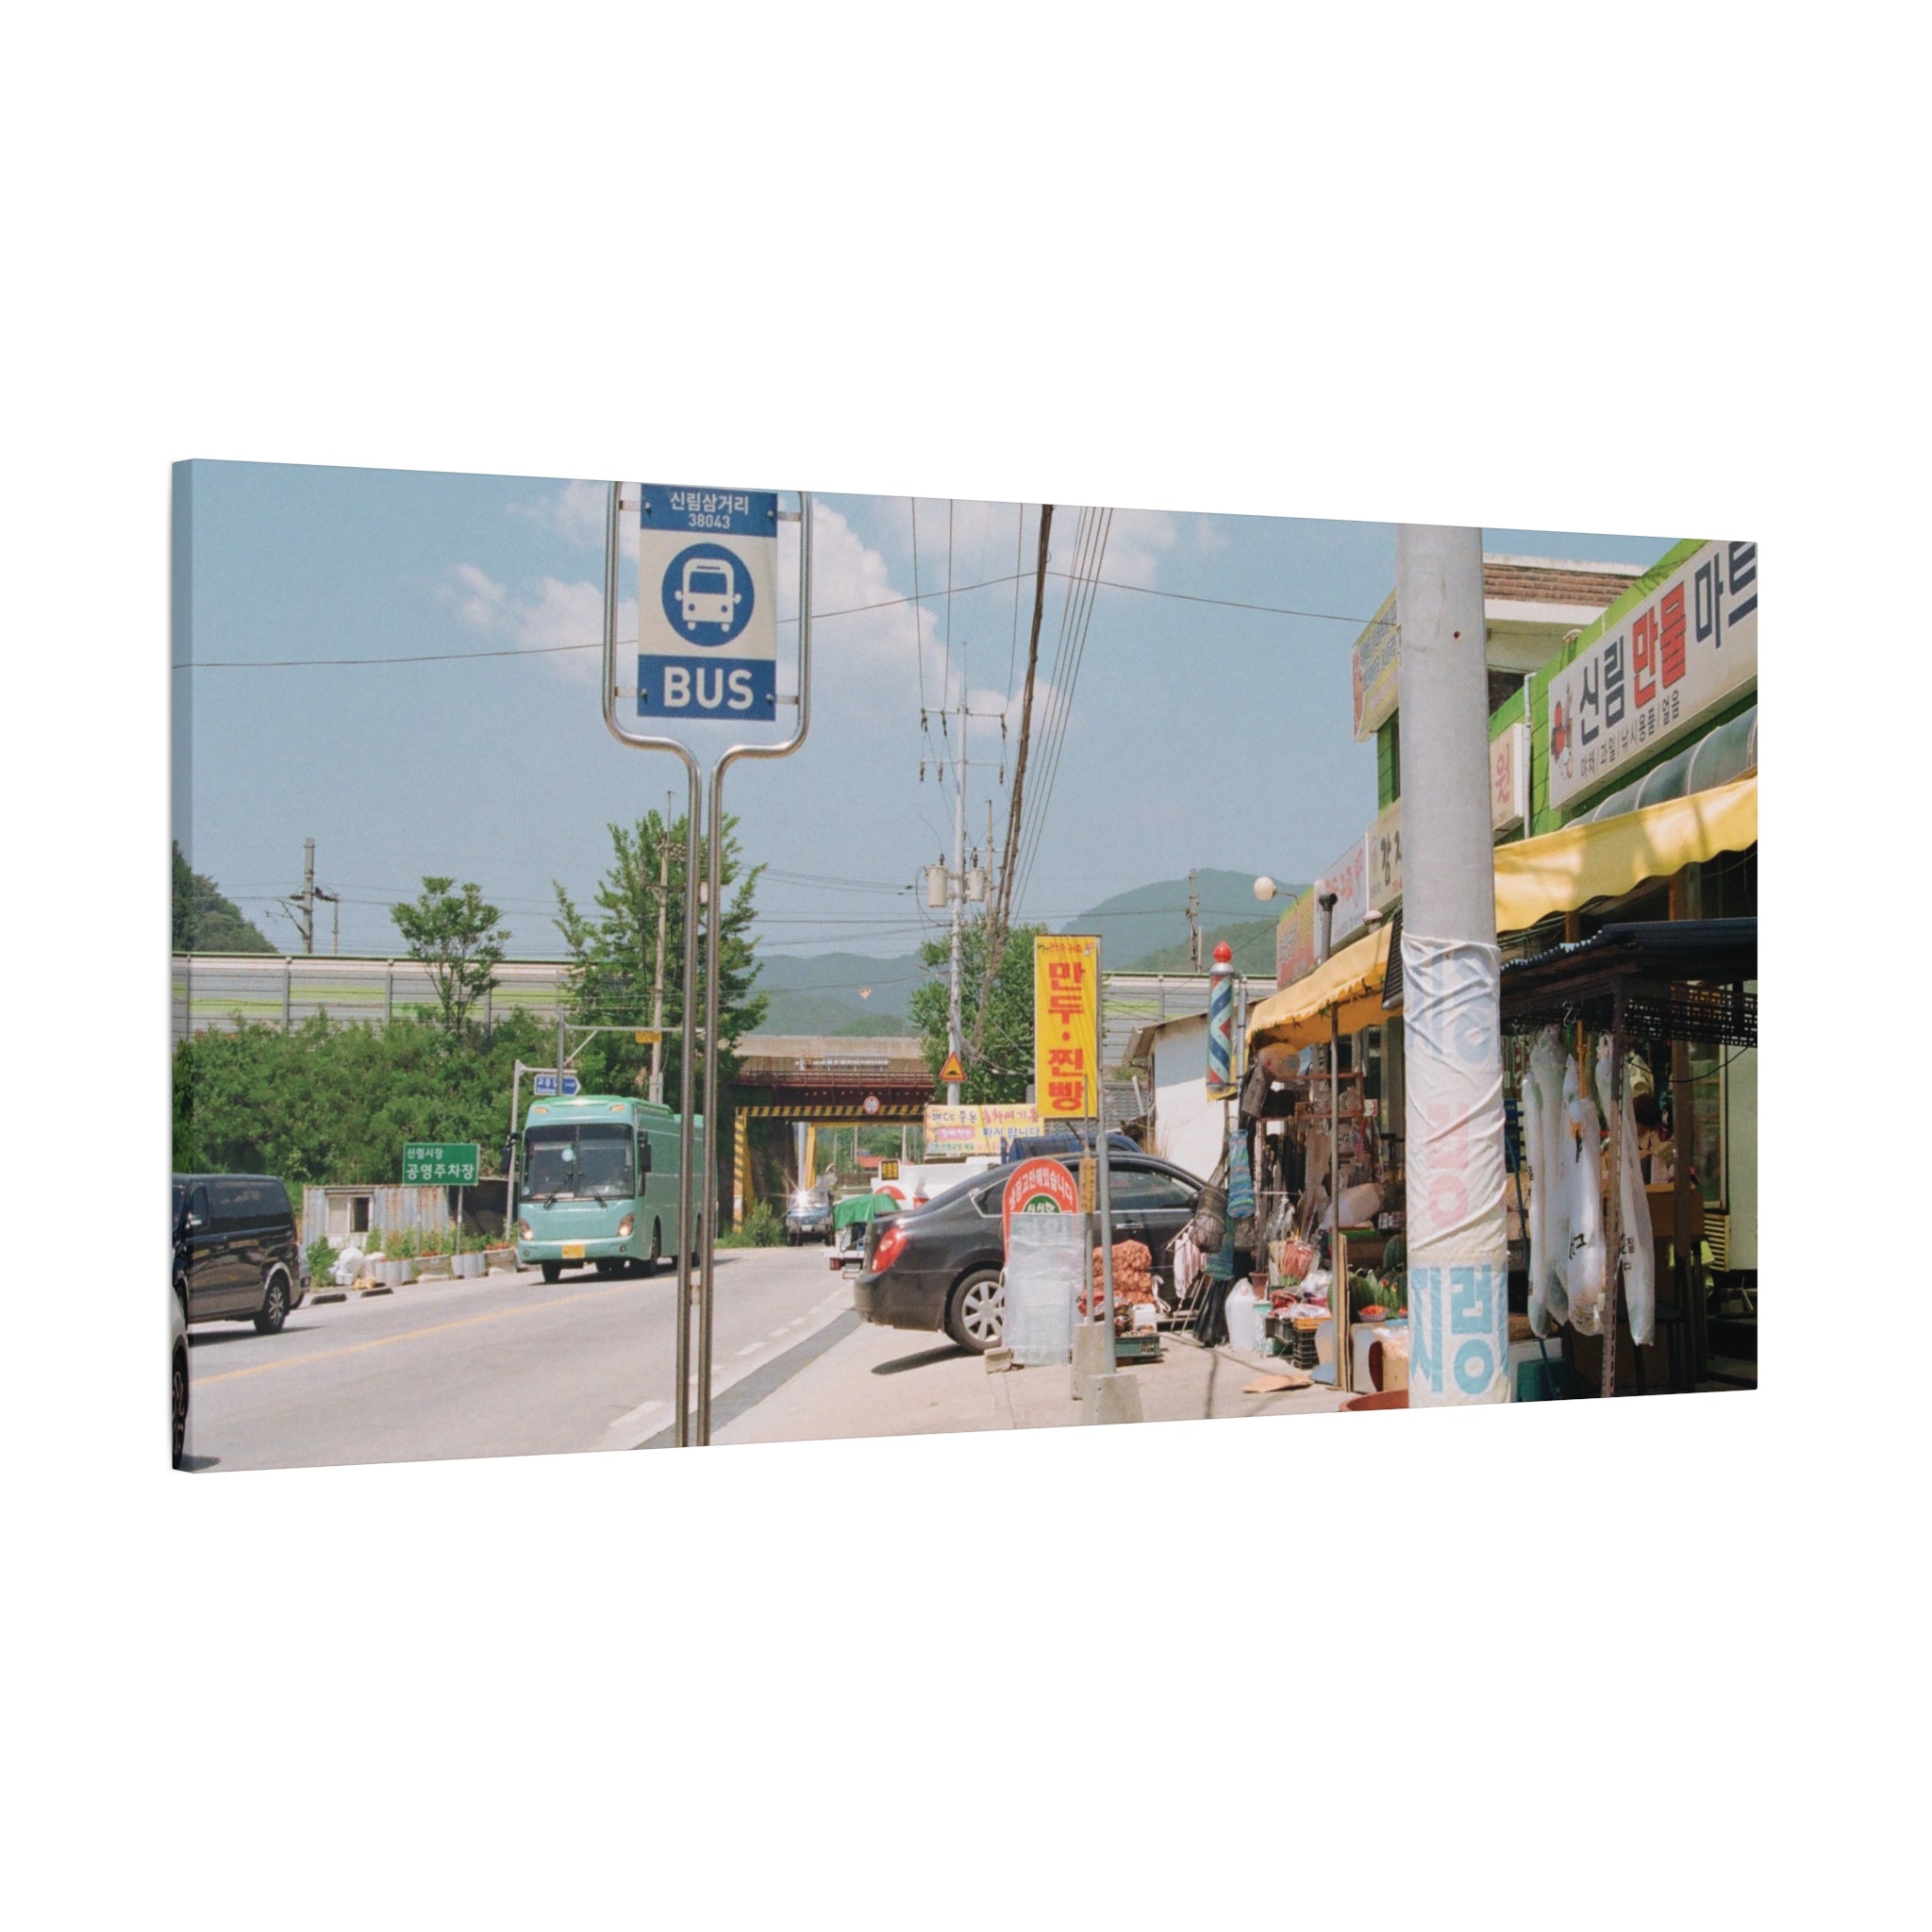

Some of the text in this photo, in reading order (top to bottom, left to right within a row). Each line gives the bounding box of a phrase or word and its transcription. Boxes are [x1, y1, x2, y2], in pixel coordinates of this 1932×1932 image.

[670, 491, 749, 515] 신림삼거리
[688, 514, 731, 529] 38043
[663, 666, 754, 710] BUS
[407, 1148, 443, 1160] 신림시장
[406, 1163, 475, 1181] 공영주차장
